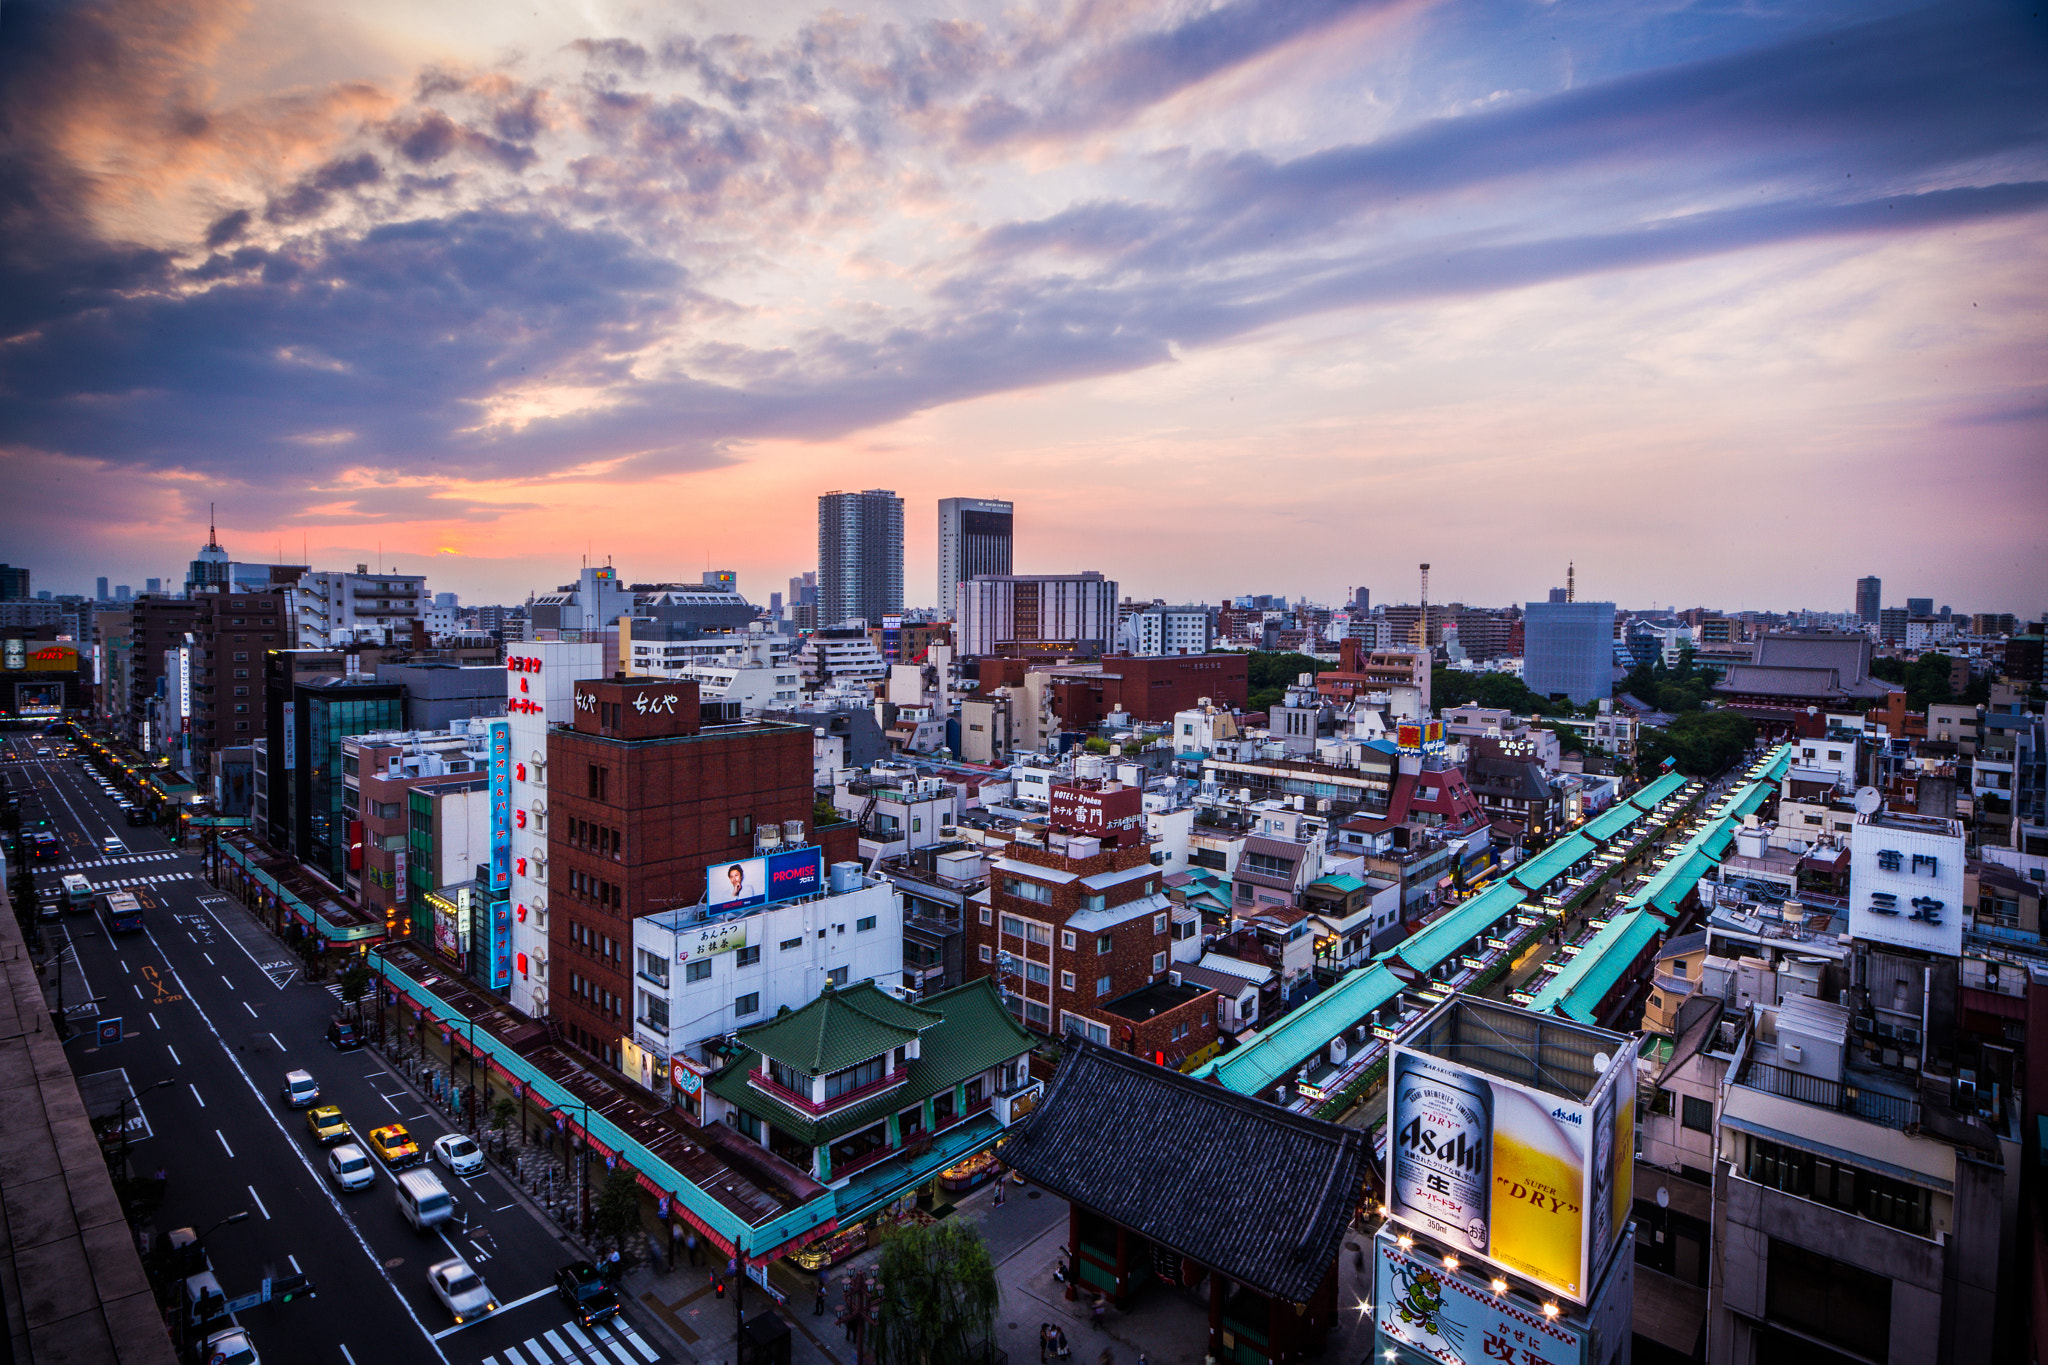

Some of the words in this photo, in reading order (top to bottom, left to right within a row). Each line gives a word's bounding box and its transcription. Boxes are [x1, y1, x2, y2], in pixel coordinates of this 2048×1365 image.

[507, 656, 541, 673] カラオケ
[520, 677, 528, 692] &
[508, 697, 543, 715] パーティー
[575, 688, 596, 714] ちんや
[632, 691, 678, 715] ちんや
[1877, 849, 1938, 878] 雷門
[773, 865, 816, 883] PROMISE
[799, 876, 815, 884] プロミス
[1867, 892, 1945, 927] 三定
[700, 925, 738, 941] あんみつ
[696, 937, 729, 954] お抹茶
[104, 1026, 115, 1036] 40
[1423, 1089, 1455, 1105] BREWERIES
[1455, 1102, 1474, 1125] LIMITED
[1552, 1107, 1582, 1125] Asahi
[1399, 1115, 1483, 1176] Asahi
[1427, 1173, 1450, 1196] 生
[1523, 1177, 1557, 1197] SUPER
[1415, 1187, 1463, 1213] スーパードライ
[1496, 1176, 1580, 1215] "DRY"
[1427, 1218, 1447, 1235] 350ml
[1498, 1321, 1541, 1351] かぜに
